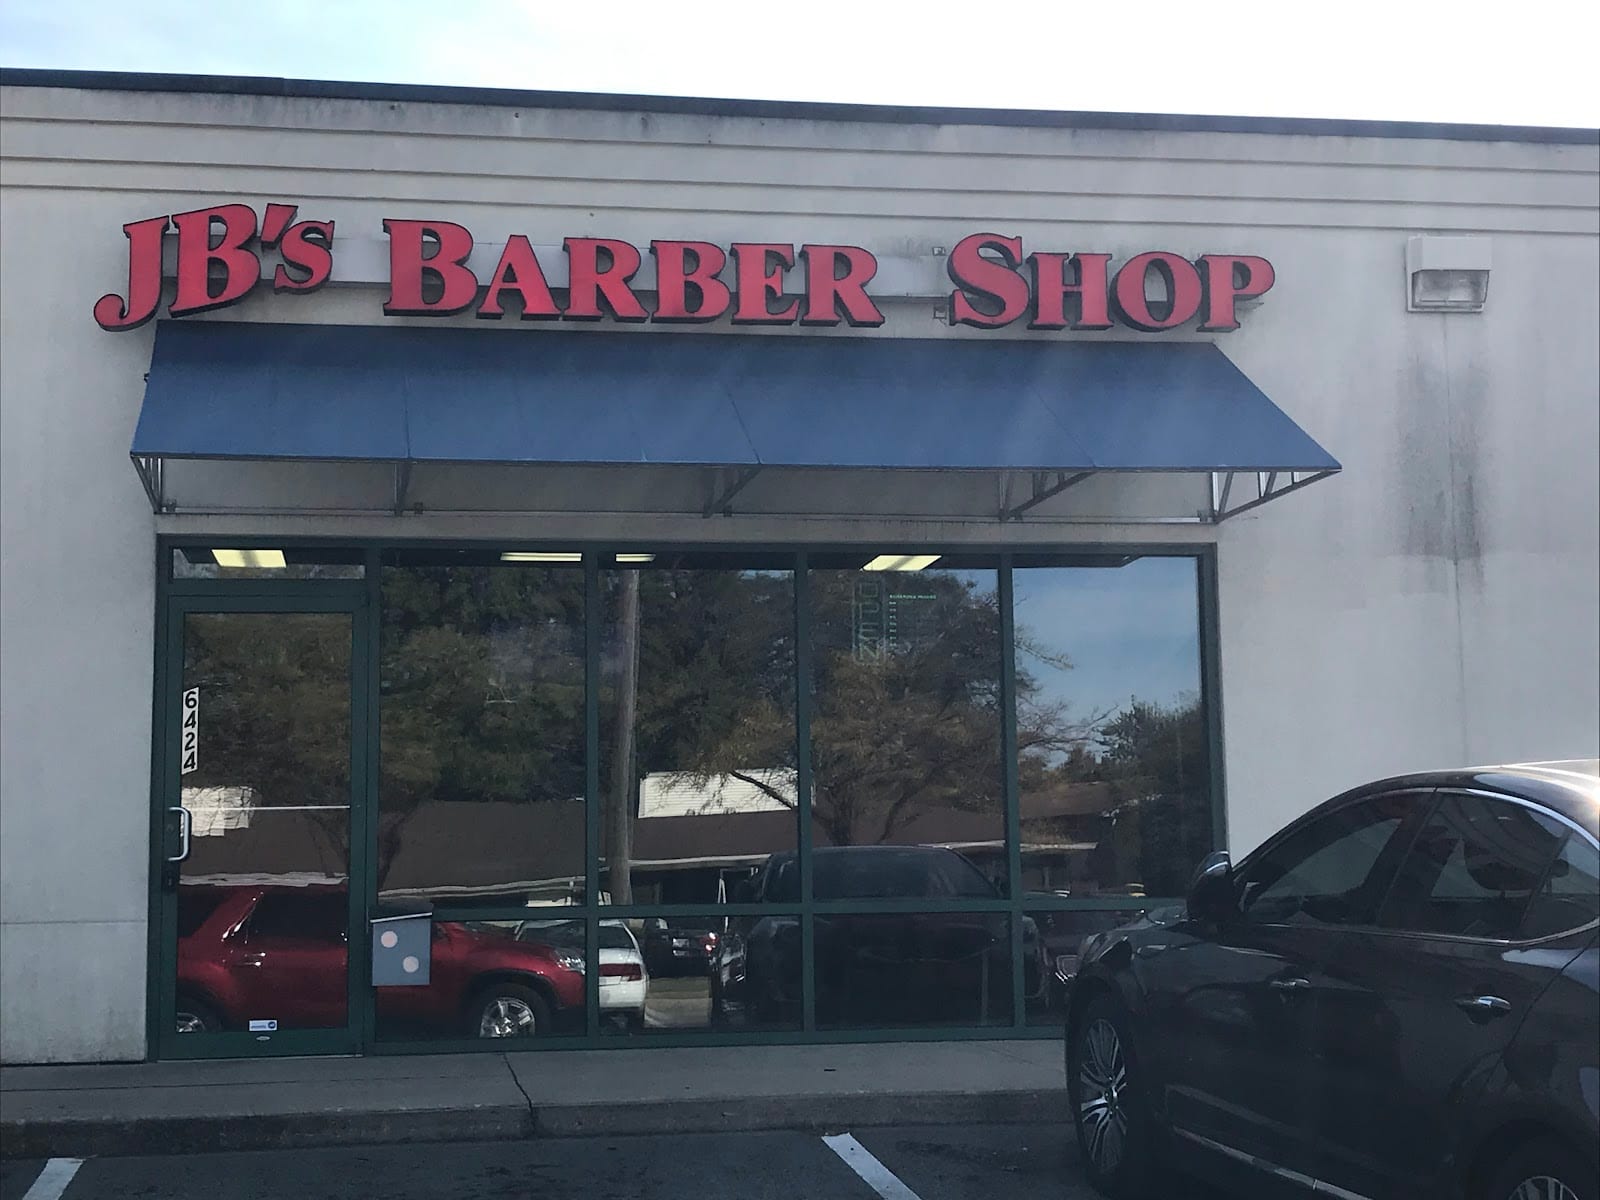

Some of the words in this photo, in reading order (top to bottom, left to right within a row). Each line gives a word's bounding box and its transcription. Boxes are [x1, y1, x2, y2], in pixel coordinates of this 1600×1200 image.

[383, 218, 885, 328] BARBER
[947, 232, 1276, 332] SHOP
[184, 690, 197, 770] 6424
